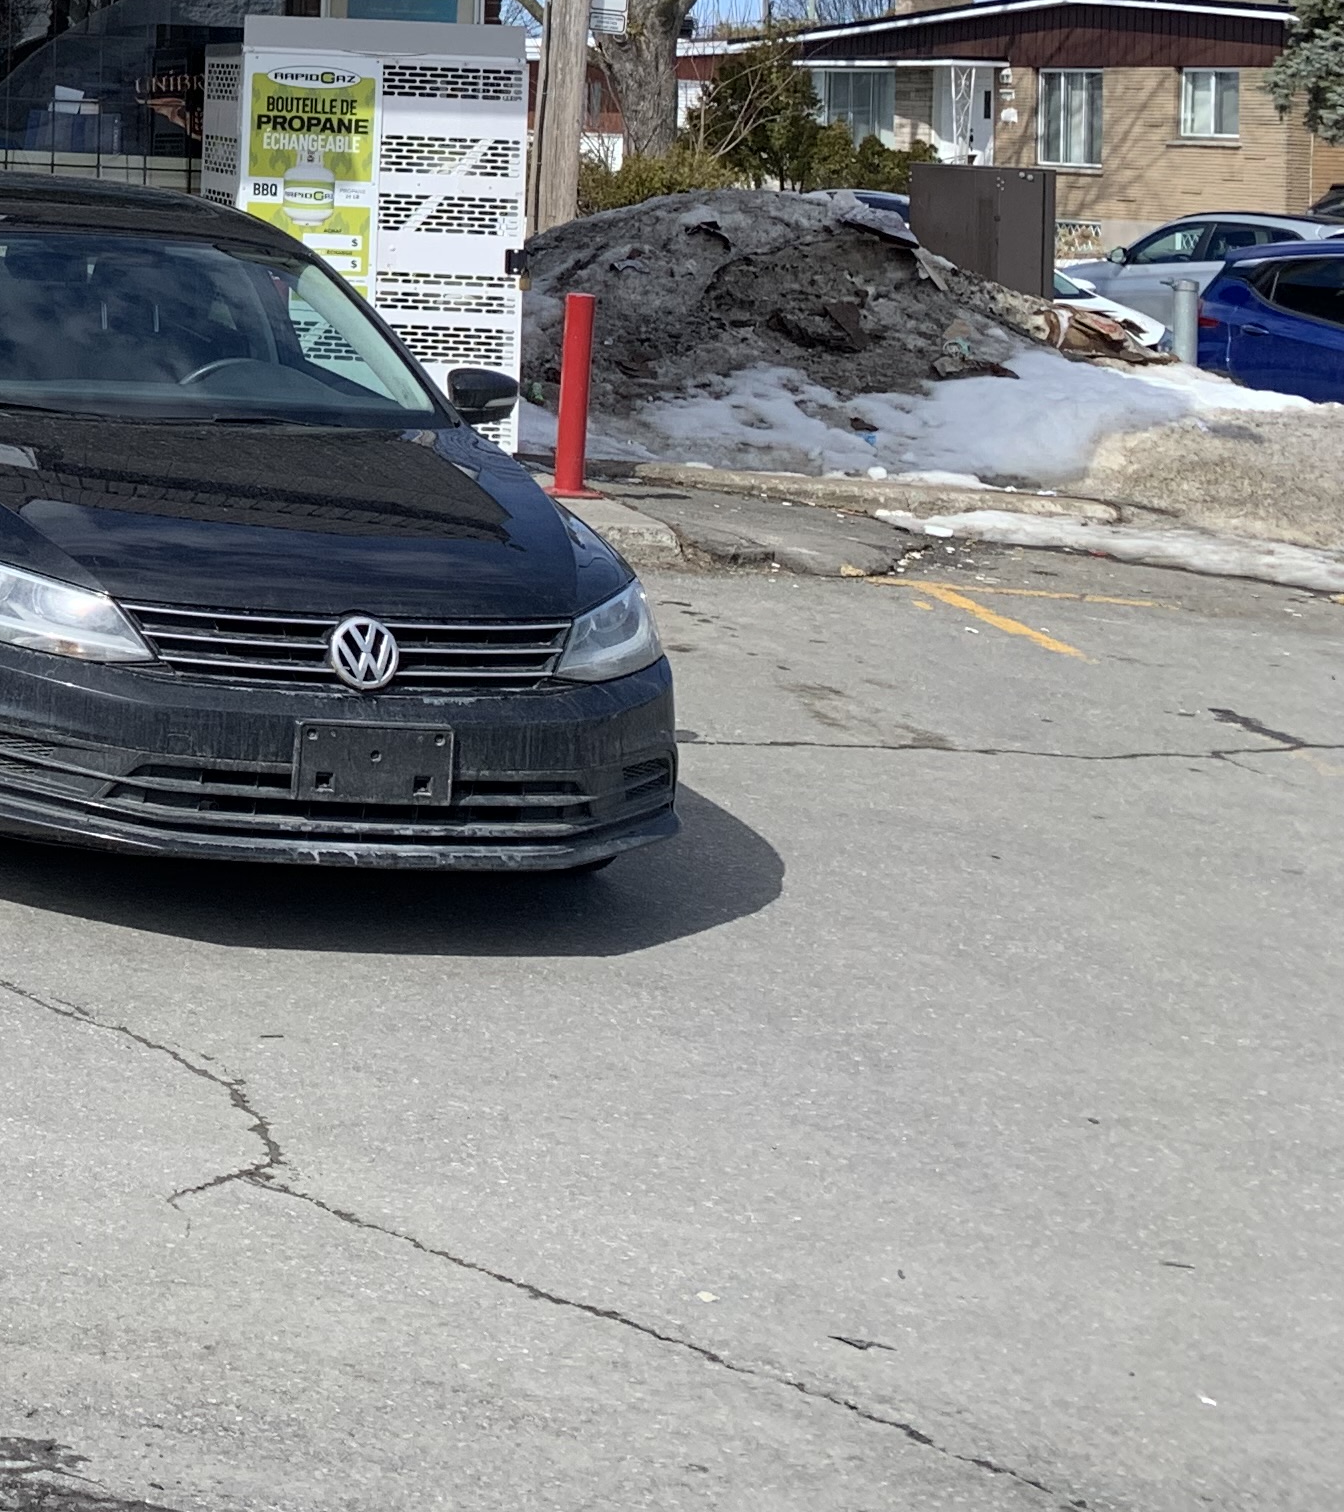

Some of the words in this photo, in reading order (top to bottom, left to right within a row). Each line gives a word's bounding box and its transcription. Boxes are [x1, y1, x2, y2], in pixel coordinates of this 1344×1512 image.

[134, 70, 205, 94] UNIBR
[266, 96, 338, 115] BOUTEILLE
[340, 99, 358, 116] DE
[257, 114, 369, 135] PROPANE
[263, 128, 361, 153] ÉCHANGEABLE
[253, 183, 278, 197] BBQ
